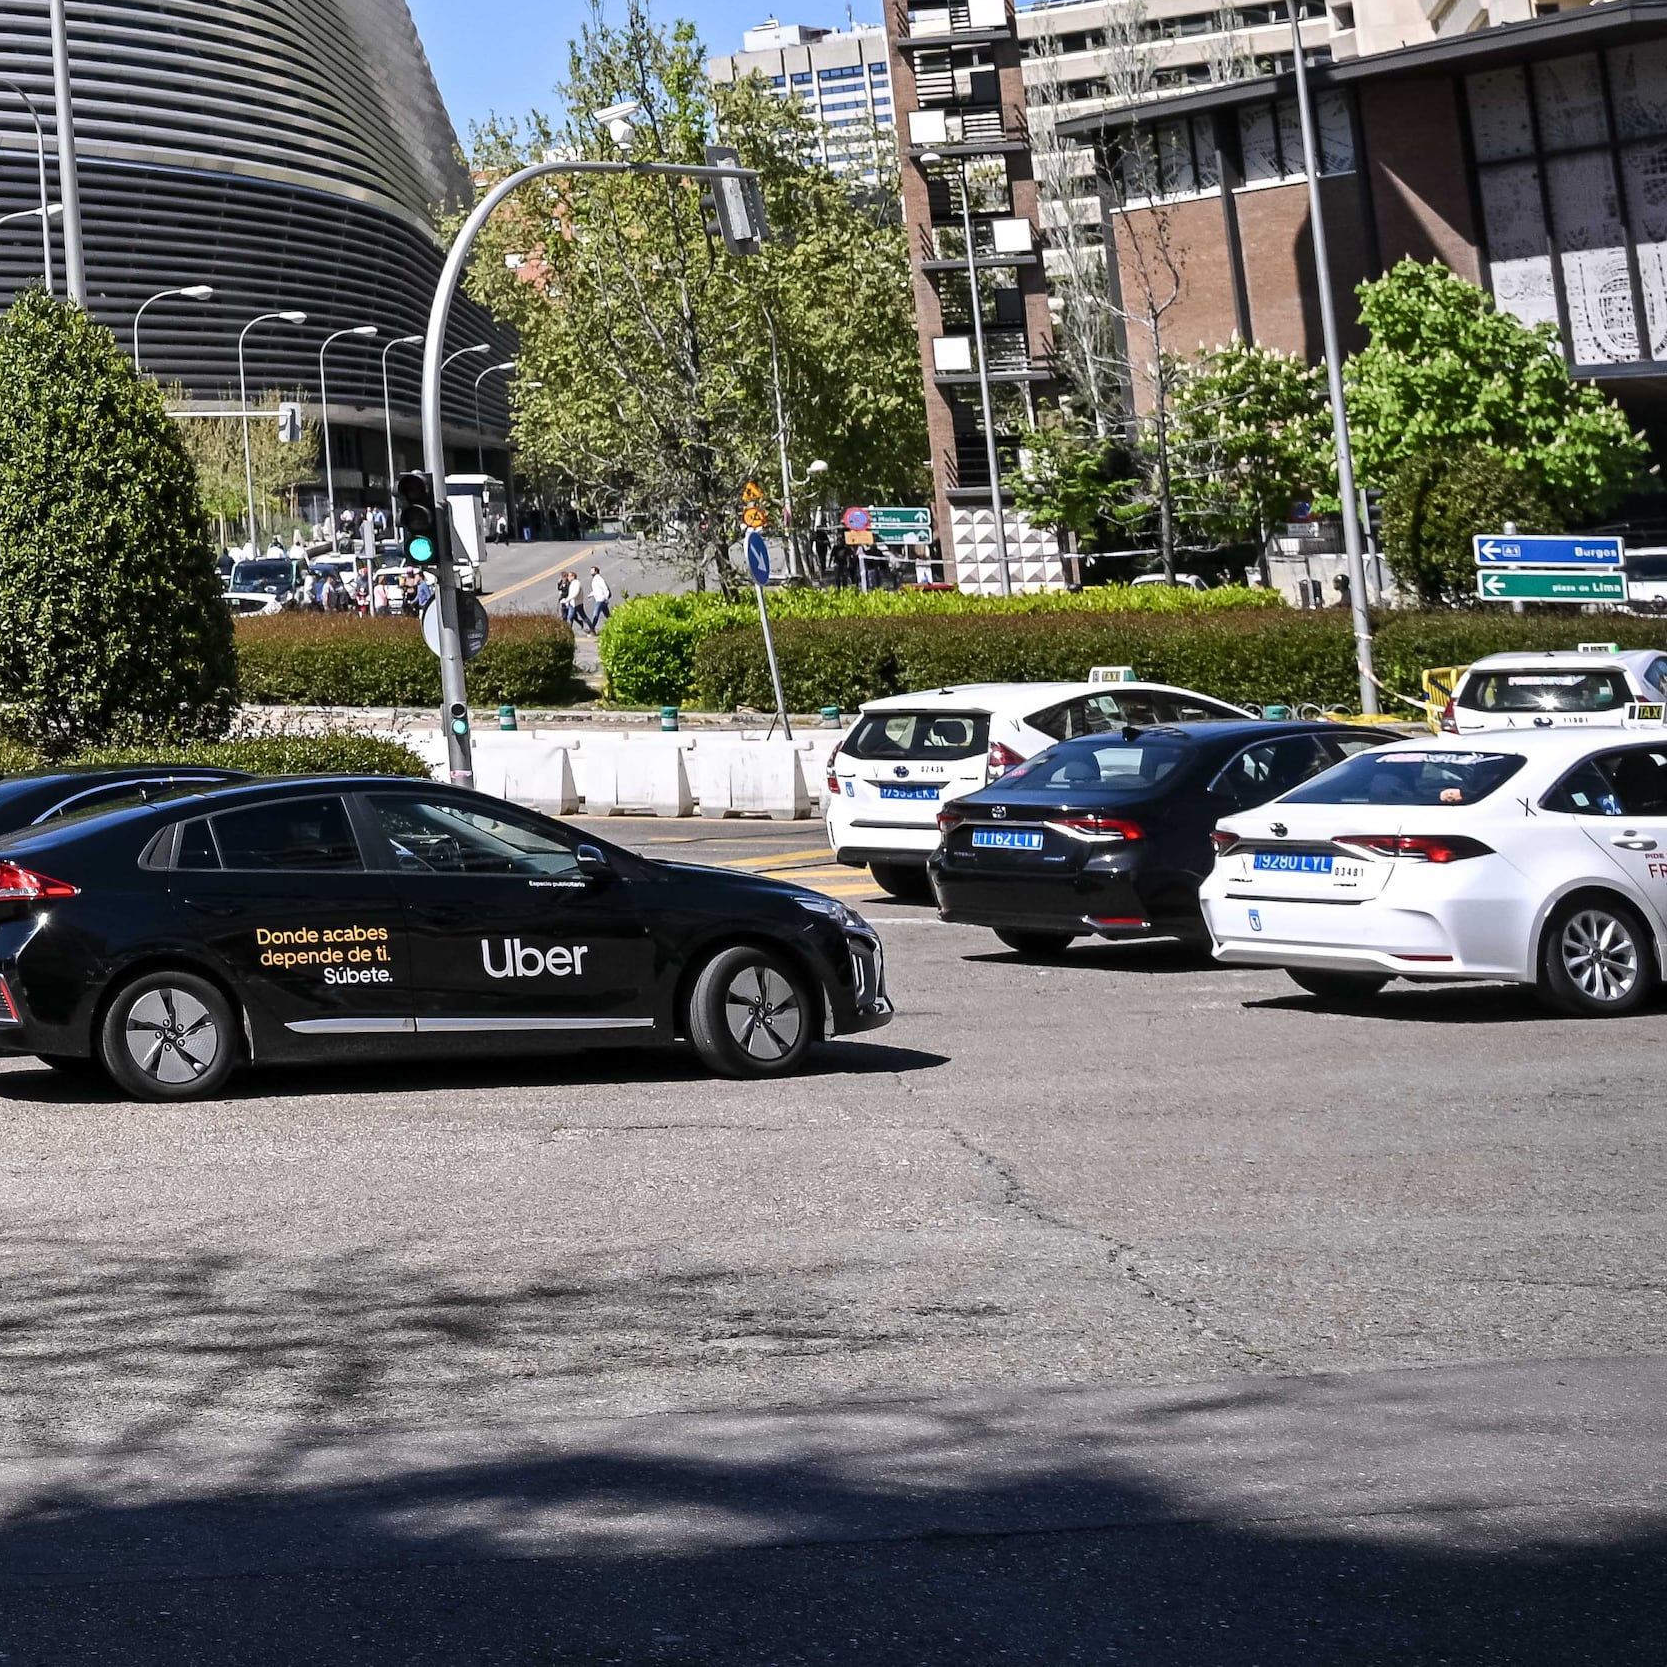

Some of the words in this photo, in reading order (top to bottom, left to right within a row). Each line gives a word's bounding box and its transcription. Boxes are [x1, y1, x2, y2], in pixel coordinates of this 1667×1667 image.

[1573, 546, 1618, 559] Burgos
[1592, 582, 1622, 593] Lima
[1639, 705, 1662, 719] TAXI
[255, 927, 319, 946] Donde
[322, 925, 389, 944] acabes
[259, 947, 344, 969] depende
[347, 945, 371, 963] de
[374, 945, 392, 962] ti.
[480, 938, 589, 979] Uber
[323, 966, 394, 985] Súbete.
